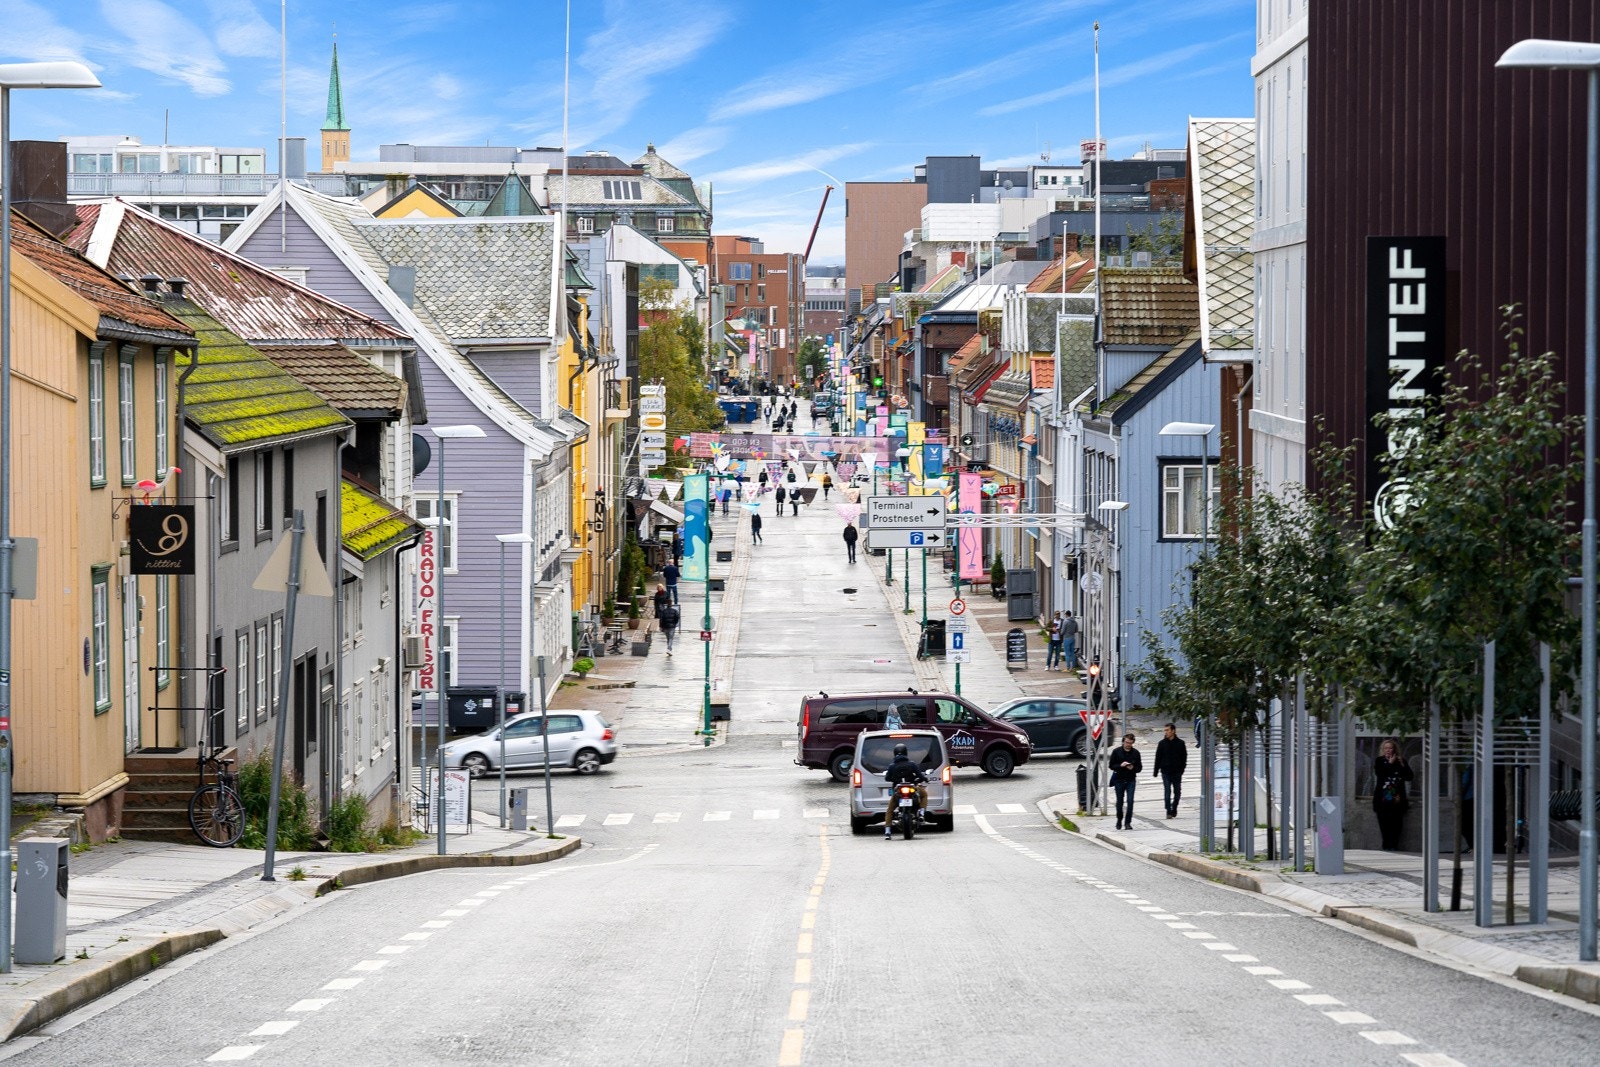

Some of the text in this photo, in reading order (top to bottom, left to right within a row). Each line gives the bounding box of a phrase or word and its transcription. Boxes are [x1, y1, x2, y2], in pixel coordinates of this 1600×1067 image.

[873, 501, 913, 510] Terminal
[595, 495, 604, 531] KINO
[873, 514, 924, 523] Prostneset
[952, 736, 975, 746] SKADI
